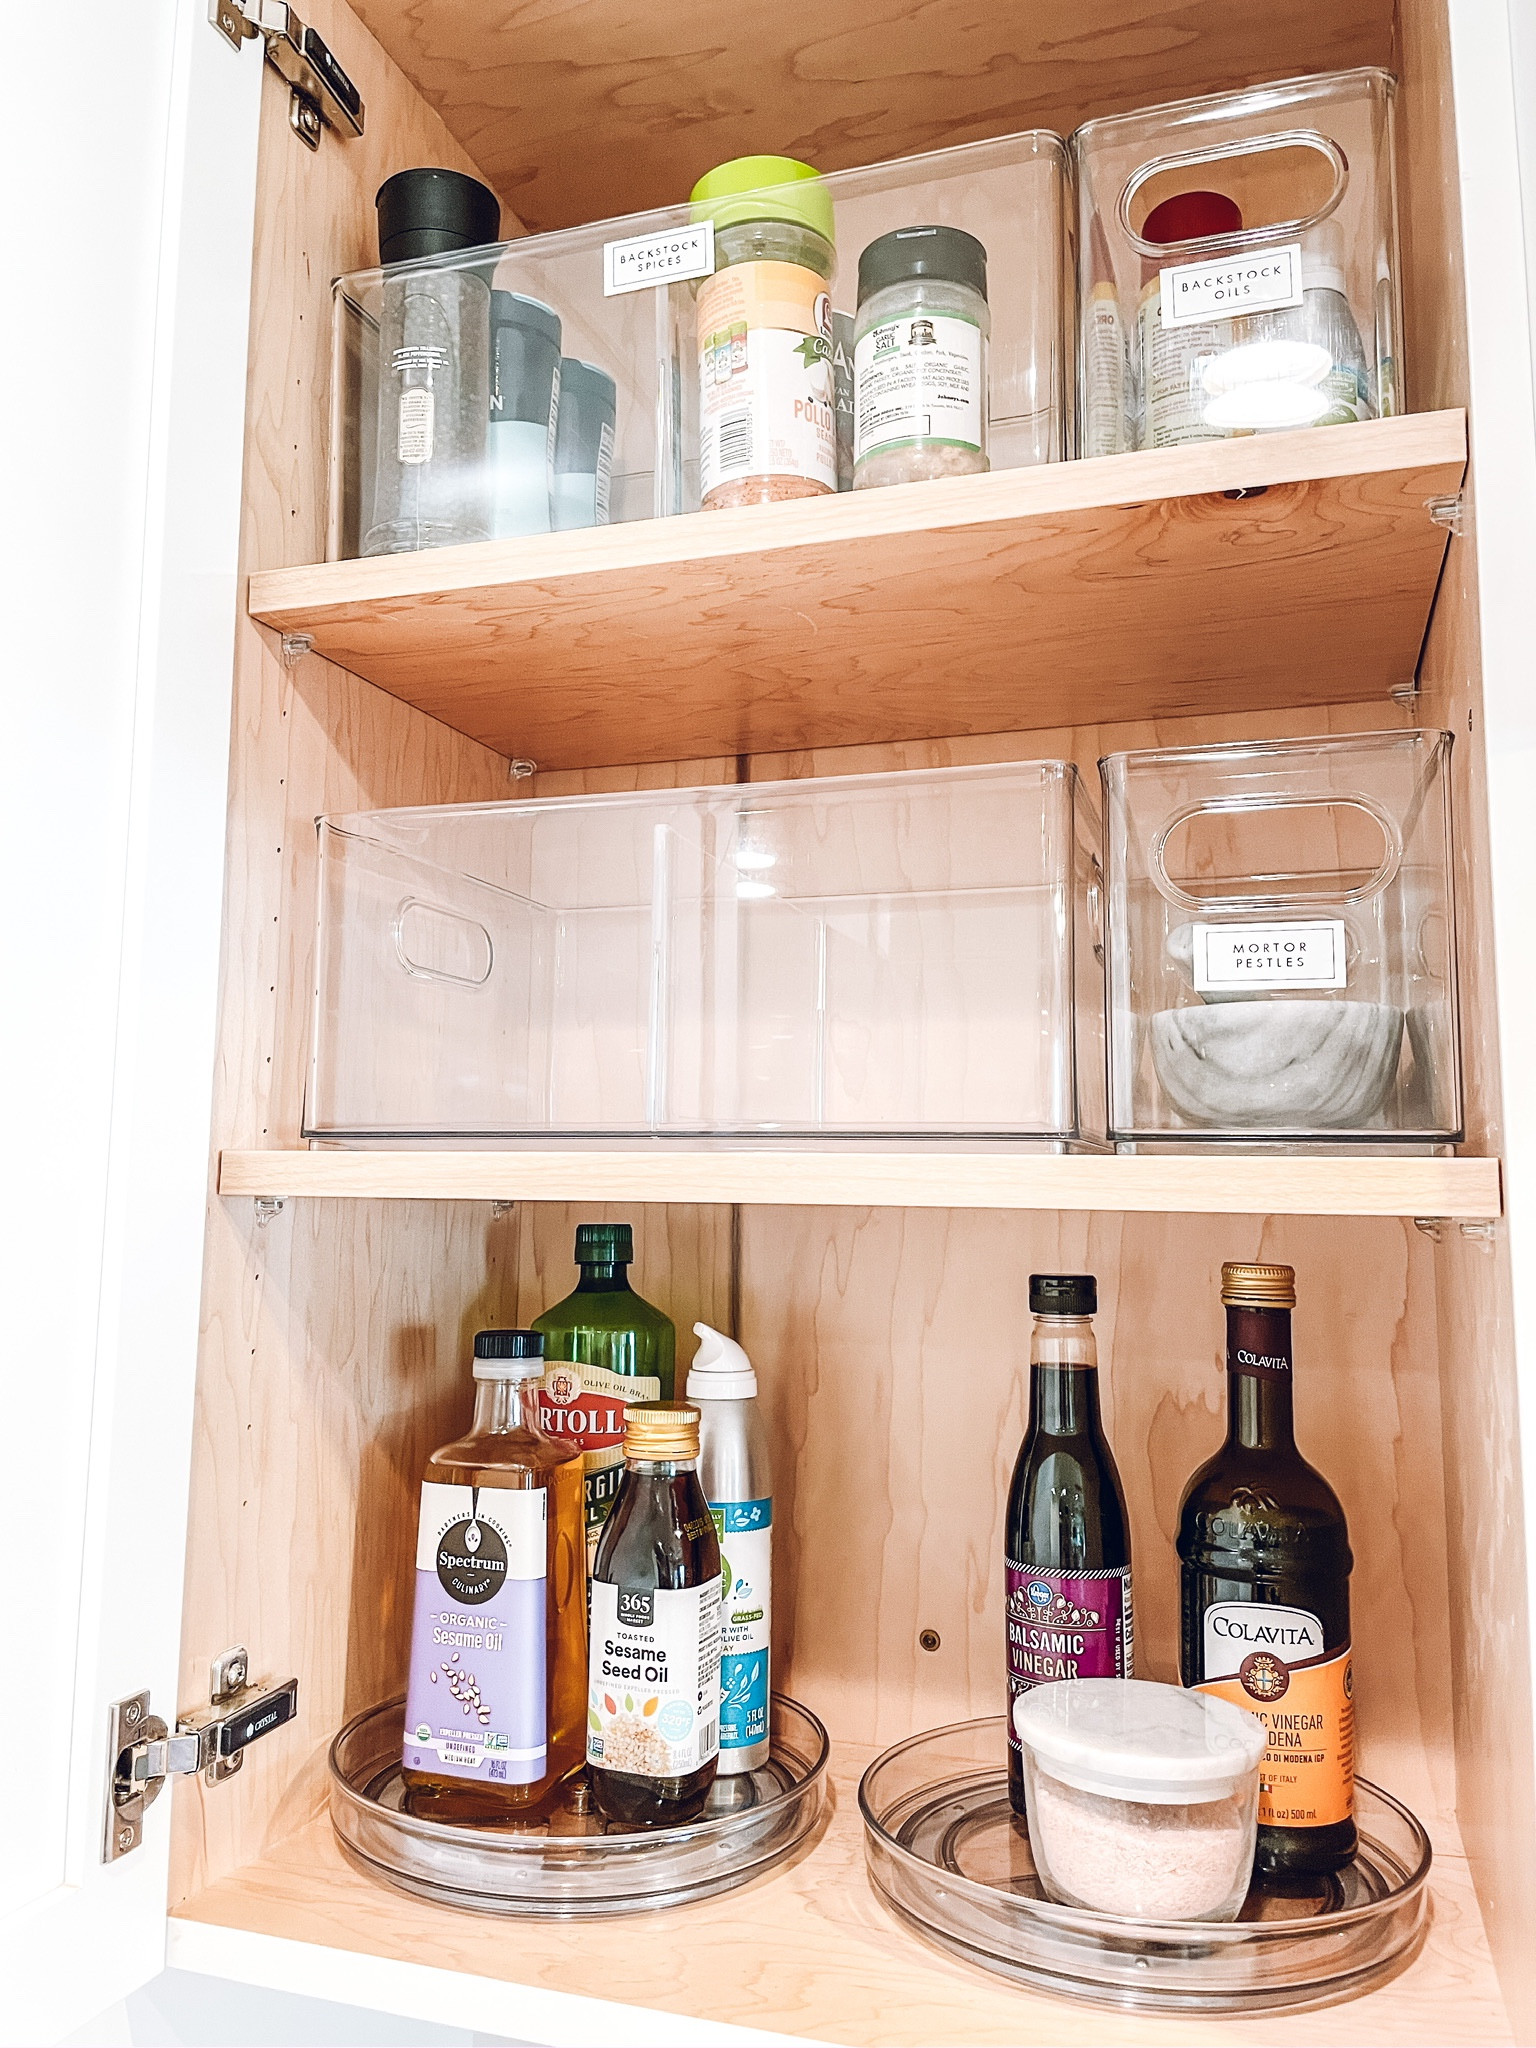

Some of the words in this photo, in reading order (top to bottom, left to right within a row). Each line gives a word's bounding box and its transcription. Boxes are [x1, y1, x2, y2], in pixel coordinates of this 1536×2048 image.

[620, 239, 698, 264] BACKSTOCK
[638, 255, 681, 272] SPICES
[1182, 265, 1281, 292] BACKSTOCK
[1214, 285, 1251, 299] OILS
[794, 399, 831, 431] POLLO
[1233, 942, 1306, 953] MORTOR
[1236, 957, 1304, 968] PESTLES
[1237, 1349, 1289, 1370] COLAVITA
[584, 1379, 611, 1389] OLIVE
[612, 1383, 628, 1393] OIL
[629, 1388, 650, 1400] BRA
[540, 1406, 627, 1434] RTOLL
[585, 1468, 624, 1502] RGI
[437, 1511, 470, 1536] PARTNERS
[439, 1551, 505, 1571] Spectrum
[620, 1593, 651, 1613] 365
[439, 1612, 498, 1630] ORGANIC
[732, 1612, 763, 1622] GRASS-FED
[433, 1627, 482, 1649] Sesame
[485, 1632, 503, 1651] Oil
[617, 1632, 655, 1643] TOASTED
[729, 1626, 749, 1634] WITH
[1009, 1621, 1085, 1655] BALSAMIC
[1213, 1616, 1314, 1646] COLAVITA
[604, 1640, 667, 1663] Sesame
[602, 1660, 641, 1680] Seed
[645, 1667, 668, 1683] Oil
[1012, 1647, 1078, 1679] VINEGAR
[254, 1711, 277, 1730] CRYSTAL
[747, 1710, 751, 1723] 5
[1271, 1713, 1324, 1731] VINEGAR
[445, 1742, 476, 1754] UNREFINED
[1268, 1731, 1302, 1748] DENA
[444, 1754, 463, 1762] MEDIUM
[464, 1757, 476, 1765] HEAT
[1274, 1754, 1281, 1762] DI
[1284, 1753, 1313, 1764] MODENA
[1315, 1753, 1325, 1763] IGP
[1280, 1774, 1298, 1783] ITALY
[1277, 1808, 1289, 1819] oz)
[1290, 1809, 1305, 1820] 500
